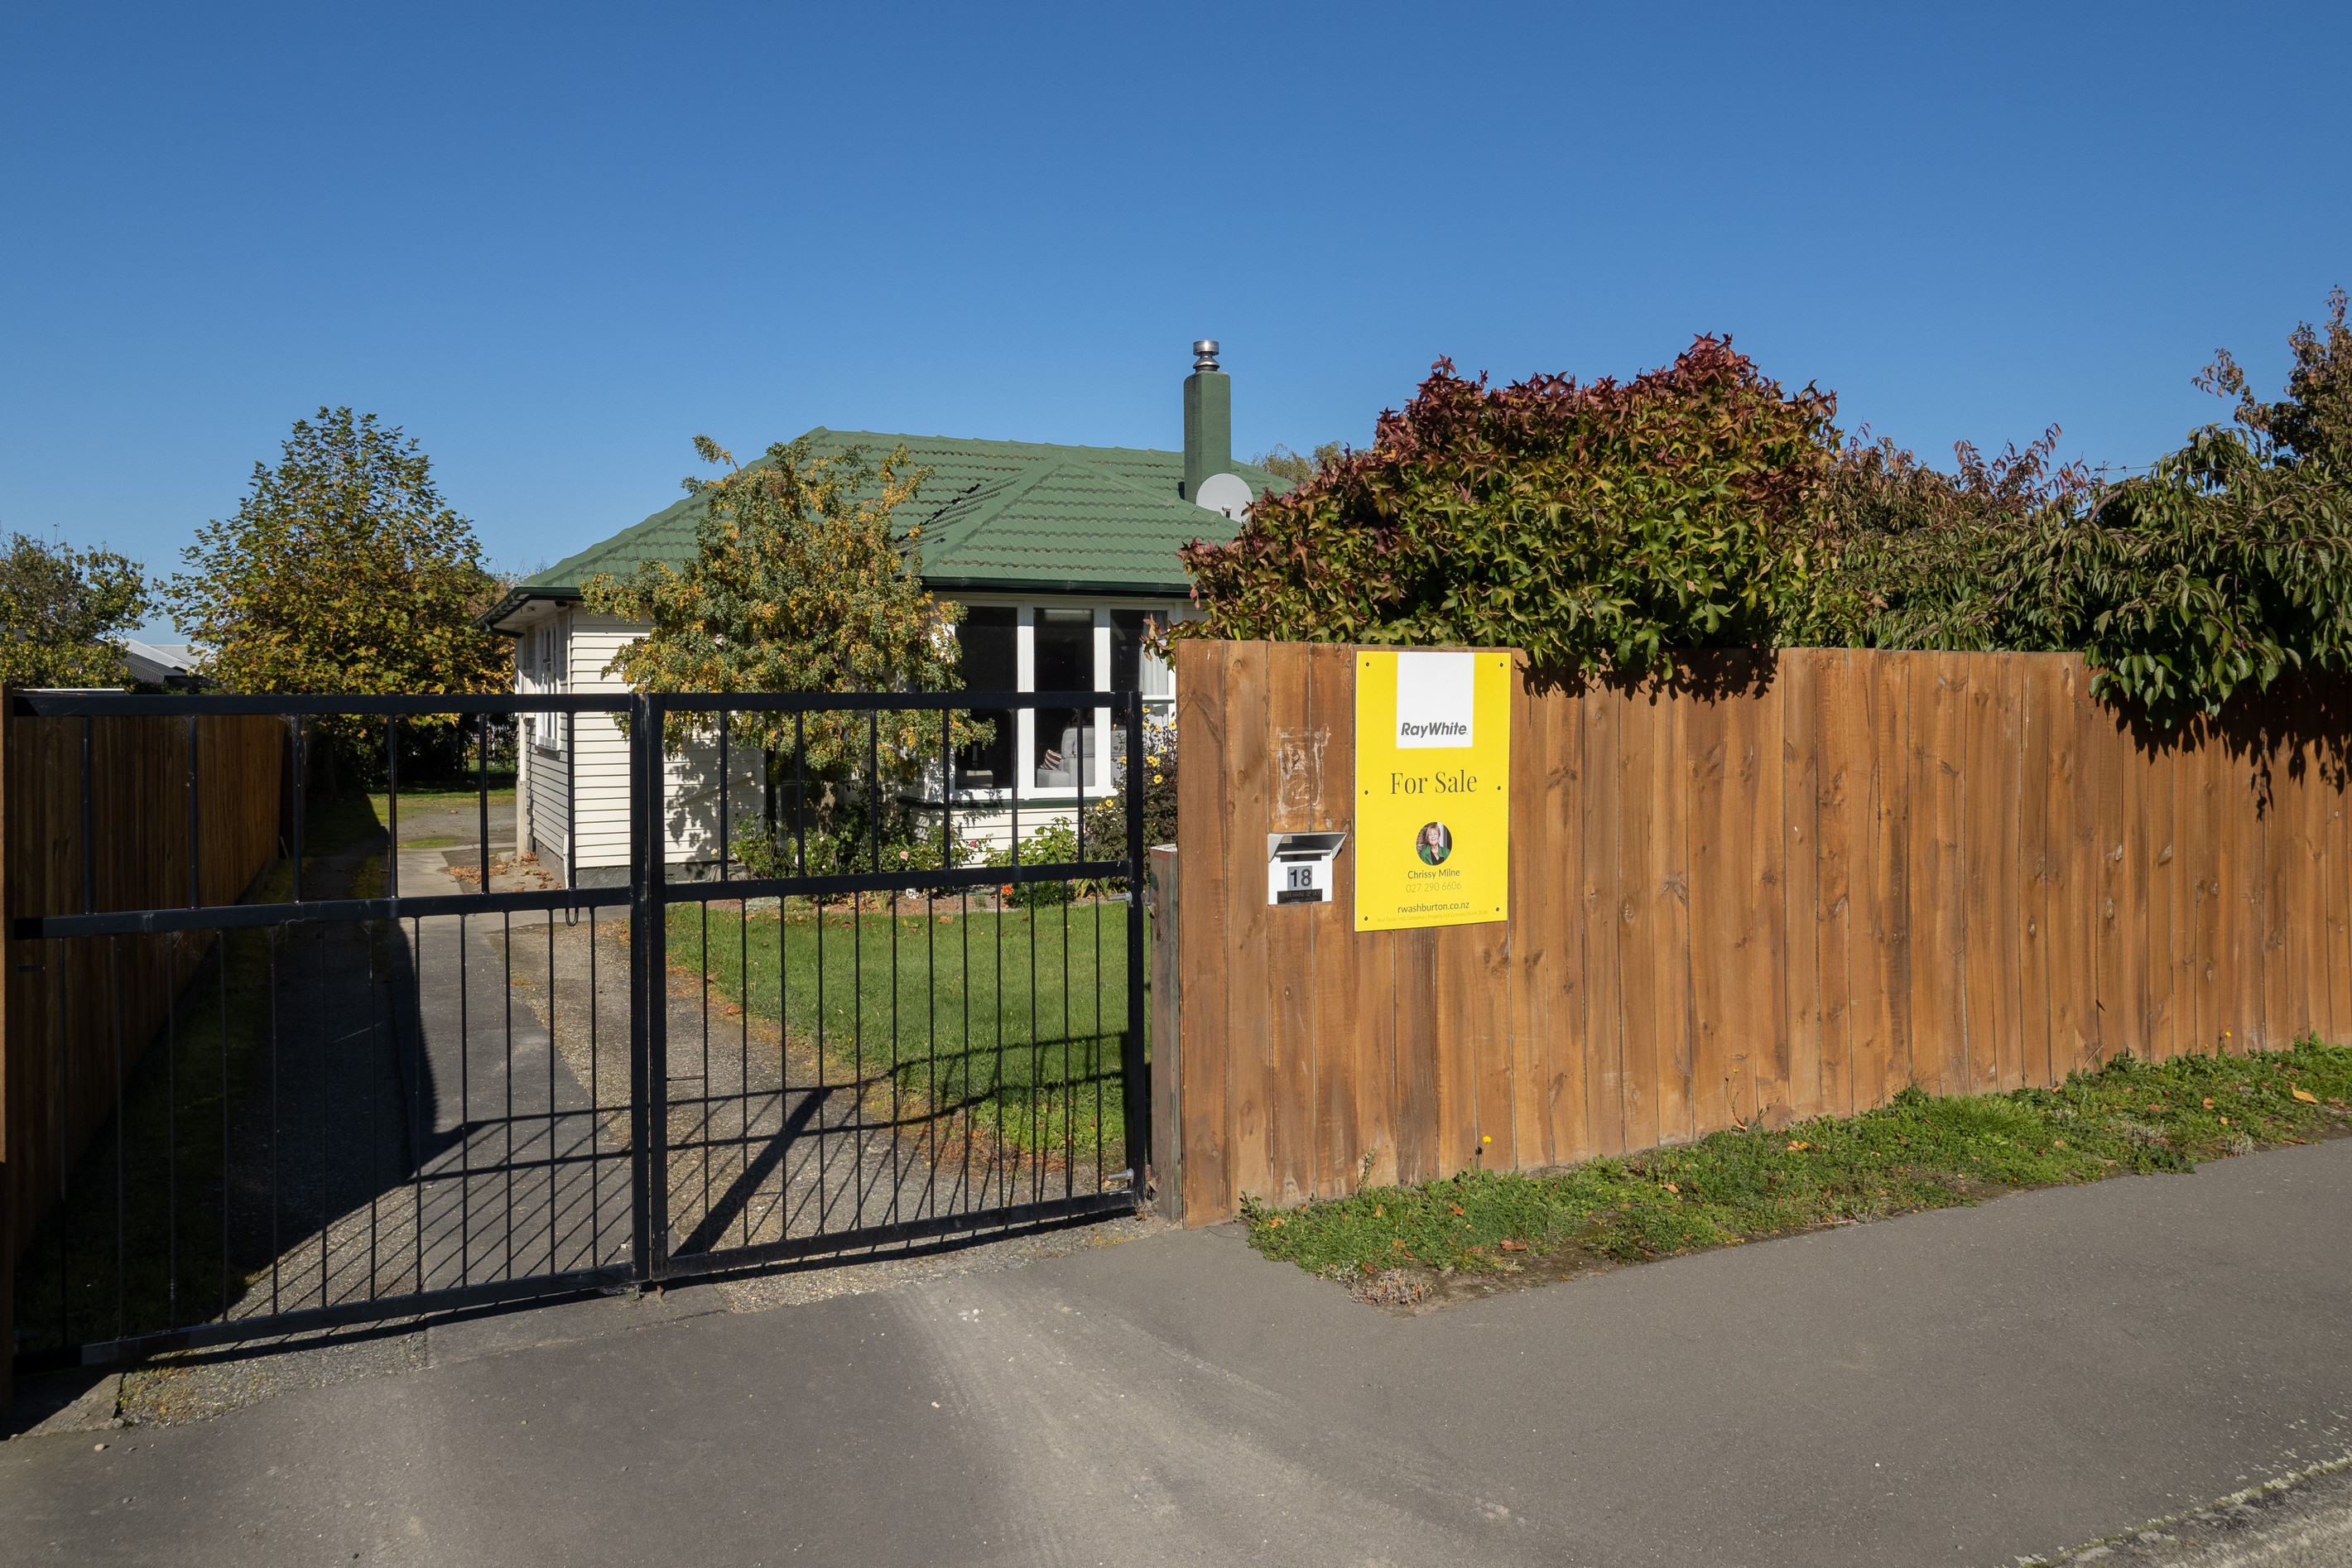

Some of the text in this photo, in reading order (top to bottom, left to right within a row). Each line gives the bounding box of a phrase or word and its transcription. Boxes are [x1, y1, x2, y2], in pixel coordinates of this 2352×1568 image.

[1401, 722, 1467, 738] RayWhite
[1390, 769, 1478, 795] For Sale
[1290, 868, 1312, 887] 18
[1407, 868, 1460, 879] Chrissy Milne
[1405, 881, 1462, 893] 027 290 6606
[1397, 902, 1469, 914] rwashburton.co.nz
